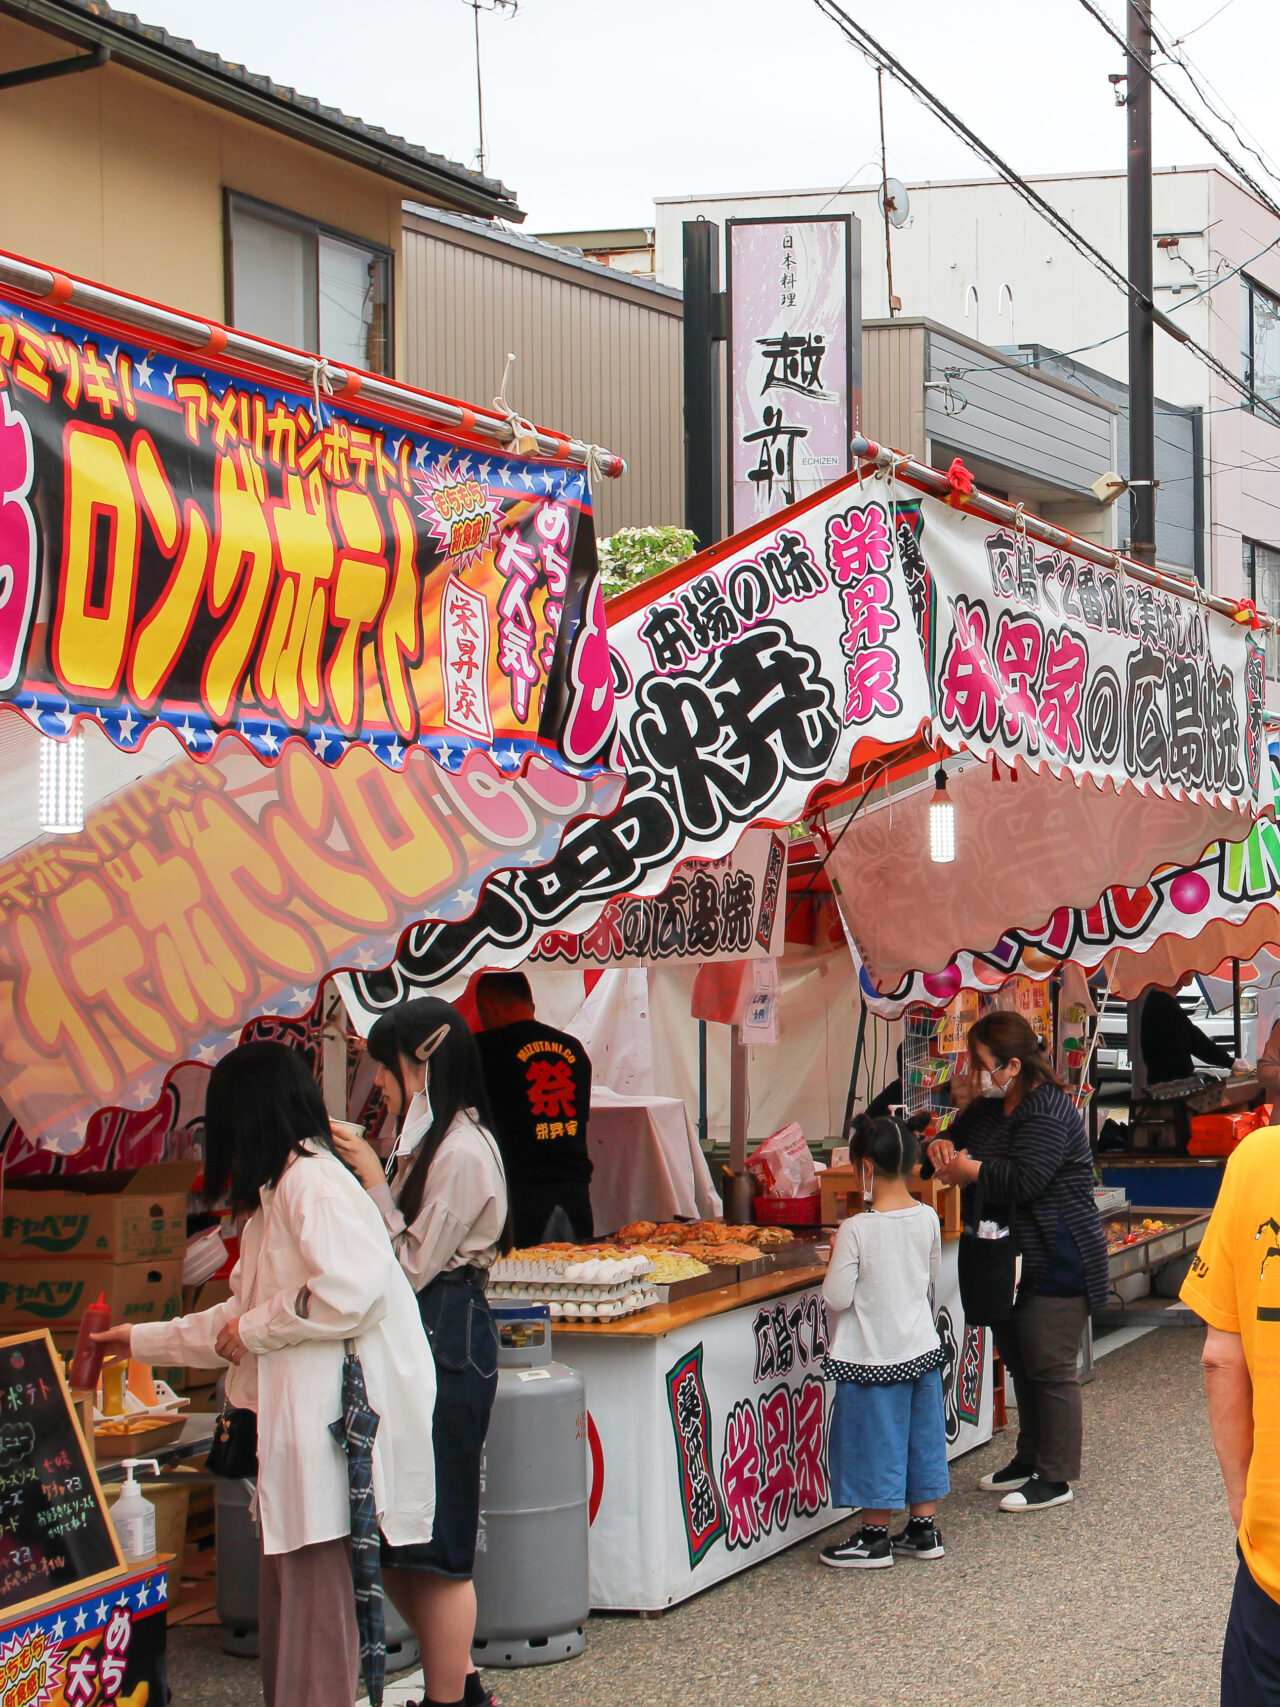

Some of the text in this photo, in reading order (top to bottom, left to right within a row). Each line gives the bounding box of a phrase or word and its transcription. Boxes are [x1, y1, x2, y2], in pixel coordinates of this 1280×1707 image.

[781, 235, 797, 308] 日本料理
[174, 377, 414, 497] アメリカンポテト!
[743, 331, 840, 505] 越前
[802, 456, 839, 466] ECHIZEN
[432, 480, 488, 522] もちもち
[52, 420, 424, 742] ロングポテト
[497, 525, 541, 723] 大人気!
[641, 530, 828, 673] 本場の味
[825, 500, 901, 727] 栄昇家
[448, 596, 484, 731] 栄昇家
[943, 596, 1243, 796] 栄昇家の広島焼
[516, 1041, 576, 1064] MIZUTANI.CO
[525, 1060, 577, 1118] 祭
[1, 1214, 90, 1254] キャベツ
[0, 1281, 85, 1320] キャベツ
[752, 1294, 829, 1384] 広島で2
[963, 1326, 980, 1410] 天地
[721, 1374, 830, 1552] 栄昇家
[100, 1605, 133, 1707] めち
